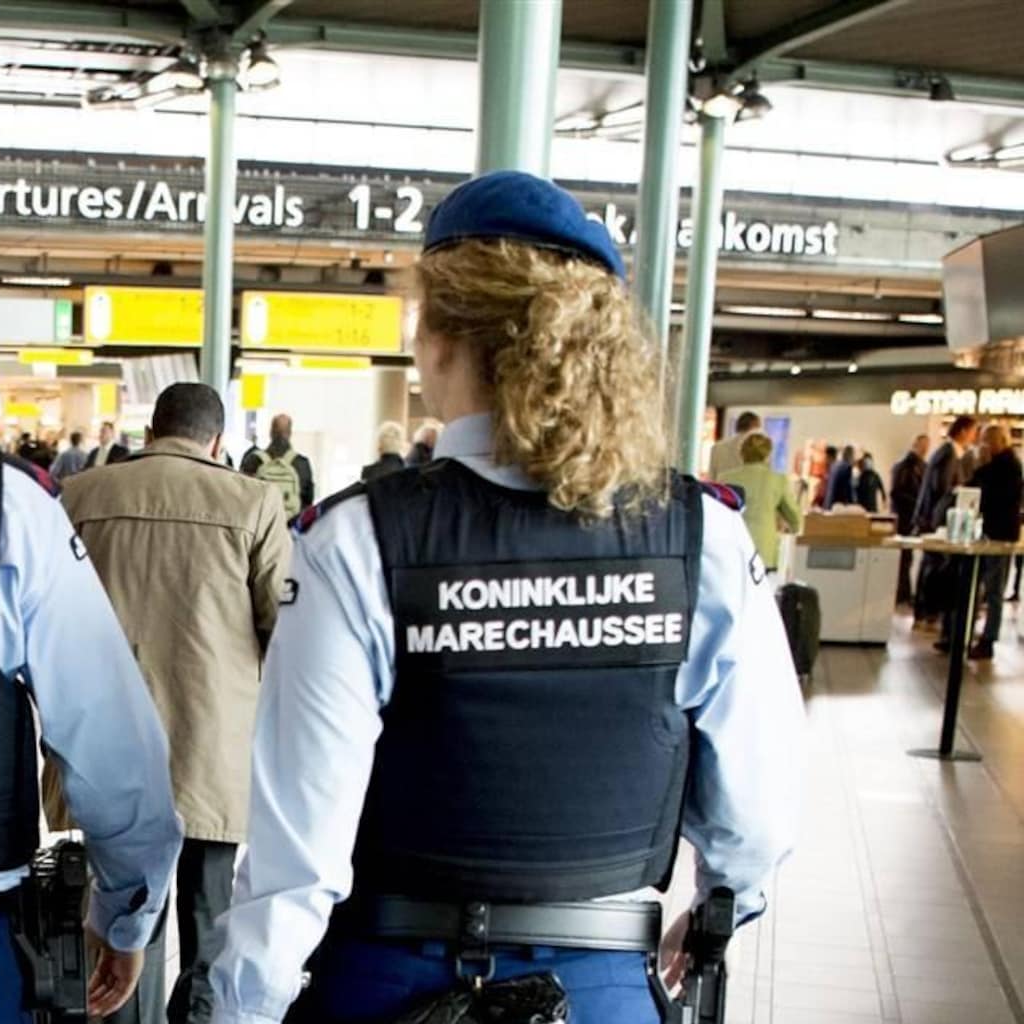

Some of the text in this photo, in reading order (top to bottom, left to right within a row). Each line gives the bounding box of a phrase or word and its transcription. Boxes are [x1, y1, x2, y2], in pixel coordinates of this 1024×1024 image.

[348, 184, 423, 232] 1-2
[438, 572, 655, 611] KONINKLIJKE
[406, 613, 682, 653] MARECHAUSSEE
